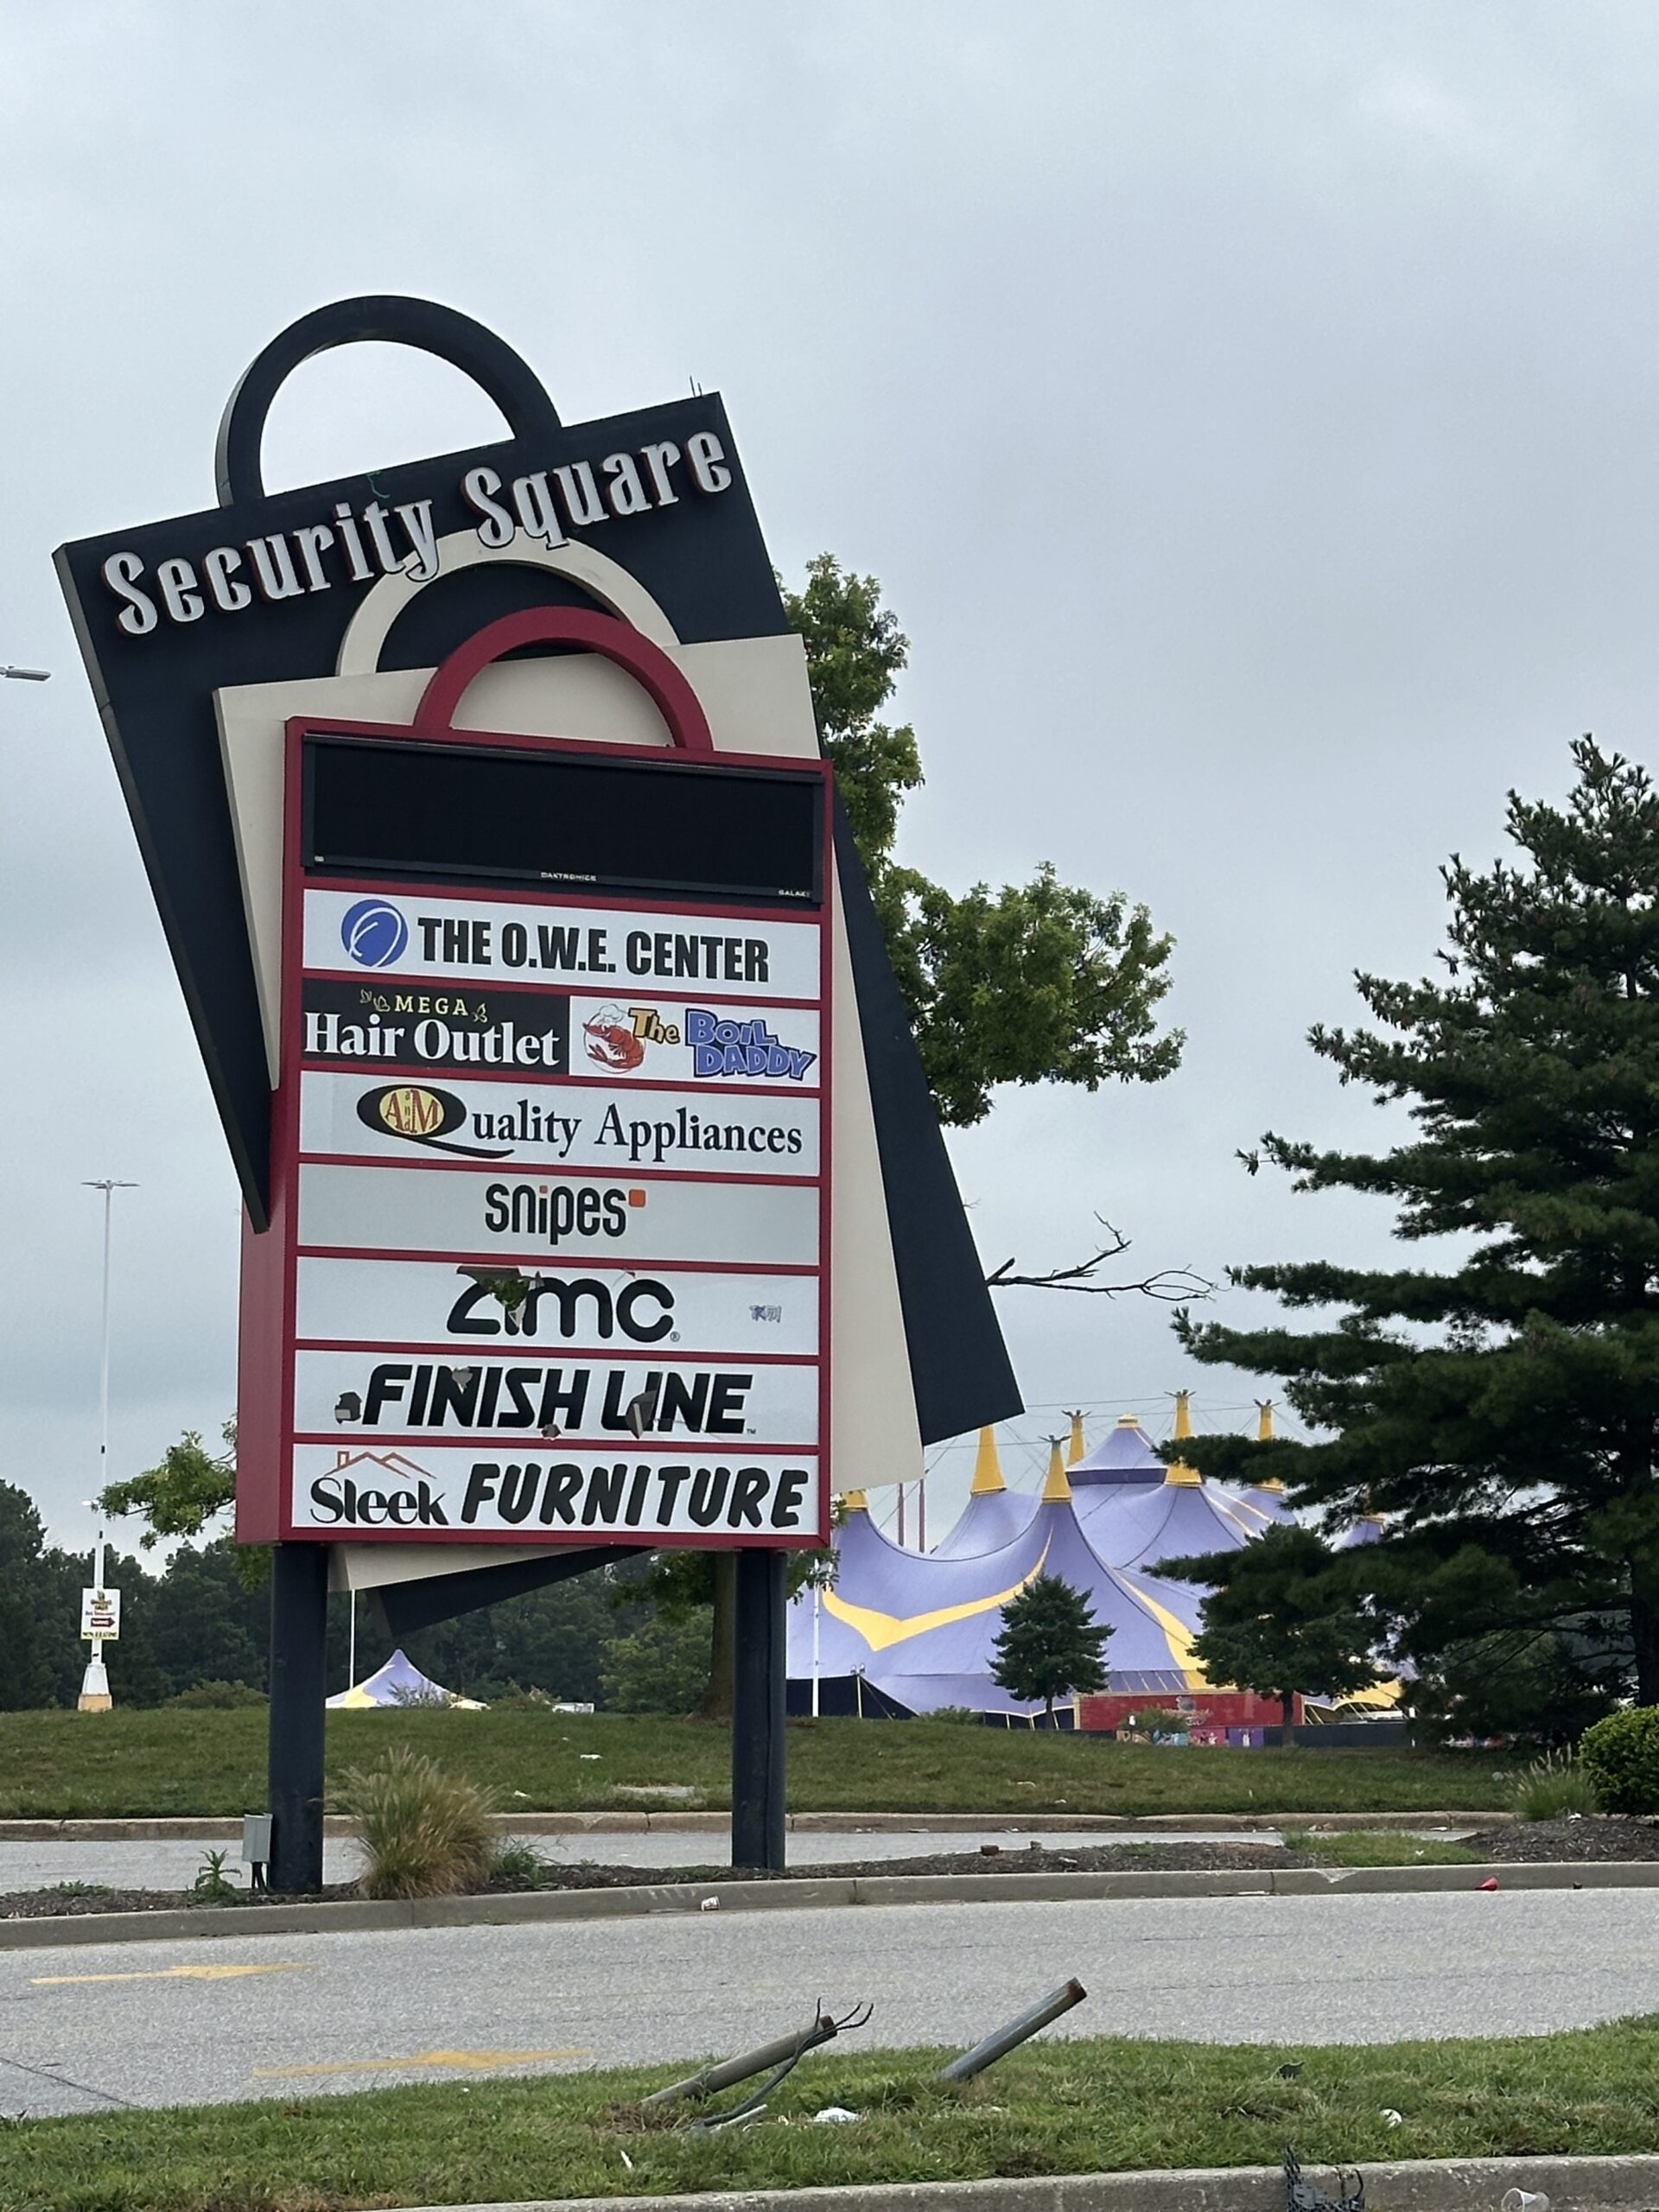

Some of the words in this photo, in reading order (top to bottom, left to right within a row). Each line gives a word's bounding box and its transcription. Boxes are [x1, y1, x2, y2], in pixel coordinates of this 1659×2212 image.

[102, 499, 442, 638] Security
[460, 429, 733, 550] Square
[417, 917, 492, 965] THE
[501, 923, 616, 973] O.W.E.
[626, 931, 769, 982] CENTER
[394, 995, 469, 1017] MEGA
[628, 1007, 680, 1046] The
[303, 1011, 405, 1058] Hair
[413, 1018, 560, 1066] Outlet
[692, 1044, 817, 1081] DADDY
[594, 1103, 803, 1162] Appliances
[361, 1363, 590, 1430] FINISH
[601, 1369, 754, 1434] LINE
[309, 1477, 448, 1526] Sleek
[461, 1463, 809, 1529] FURNITURE
